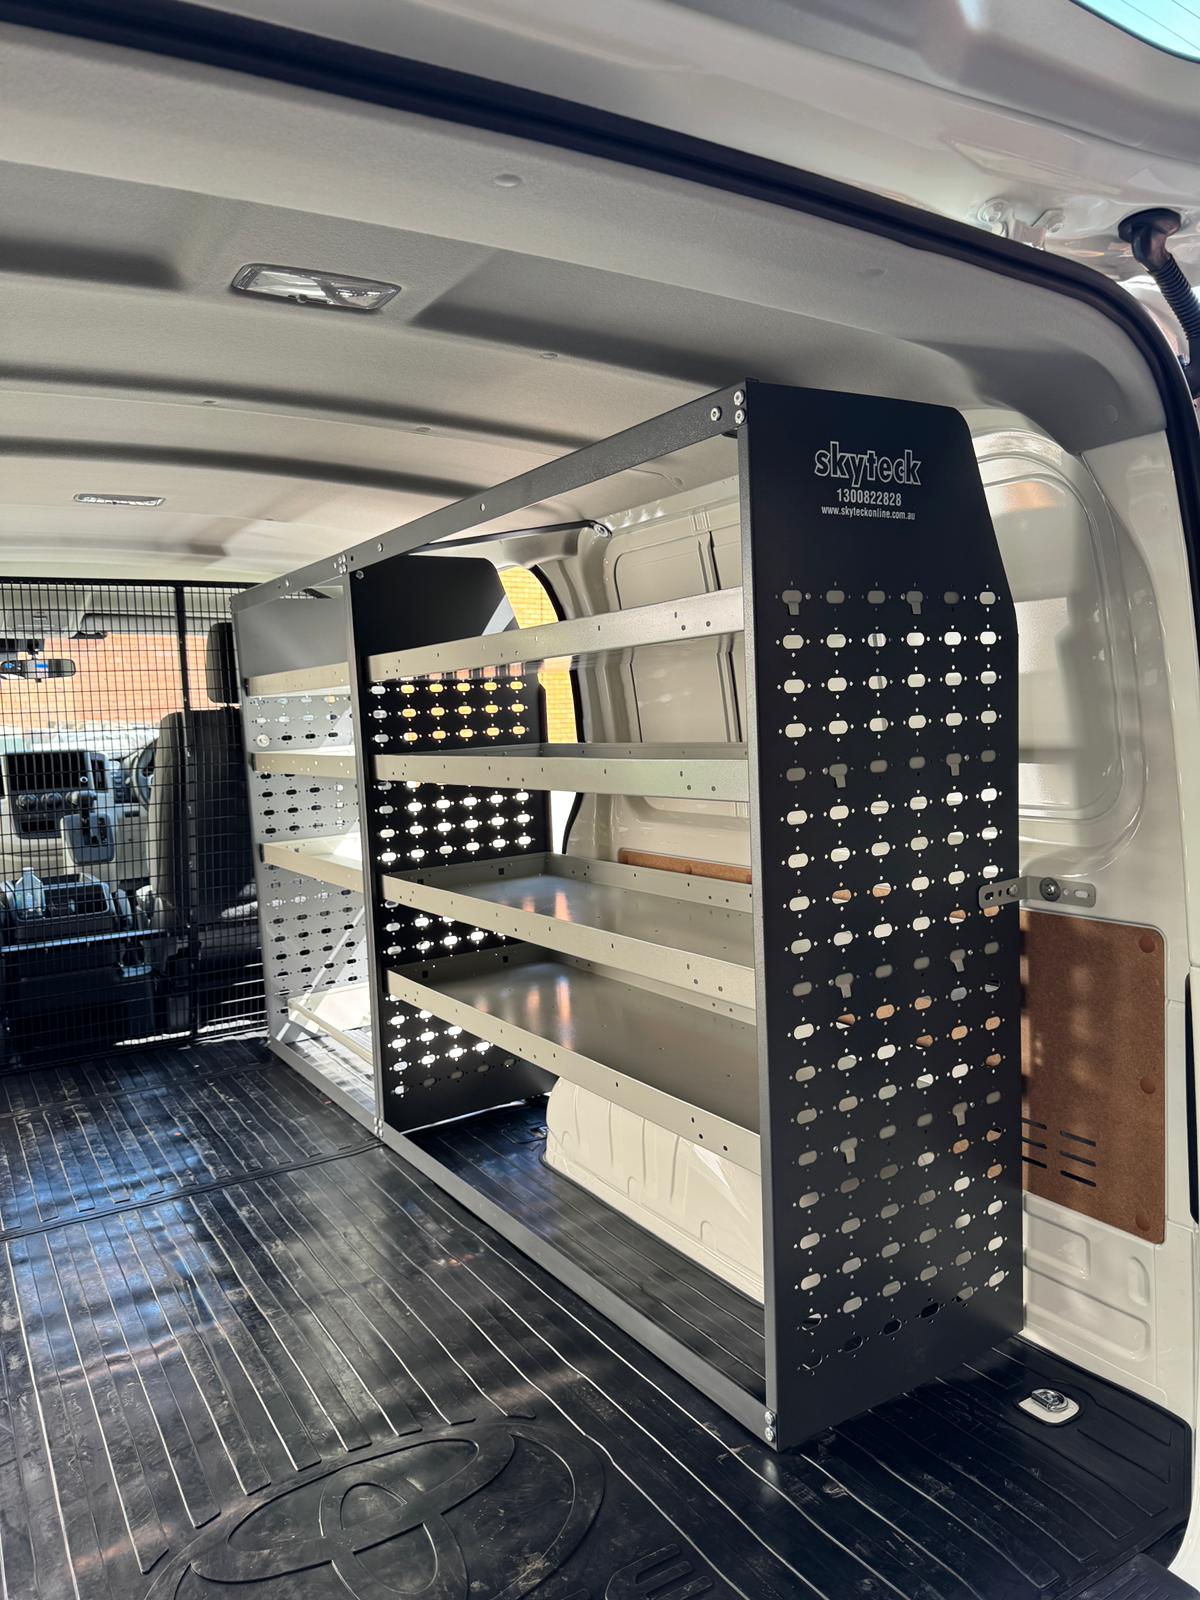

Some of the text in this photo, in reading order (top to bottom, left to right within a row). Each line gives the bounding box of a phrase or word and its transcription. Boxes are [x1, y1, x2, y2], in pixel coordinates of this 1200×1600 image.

[814, 441, 921, 487] skyteck
[836, 488, 902, 506] 1300822828
[821, 505, 916, 520] www.skyteckonline.com.au
